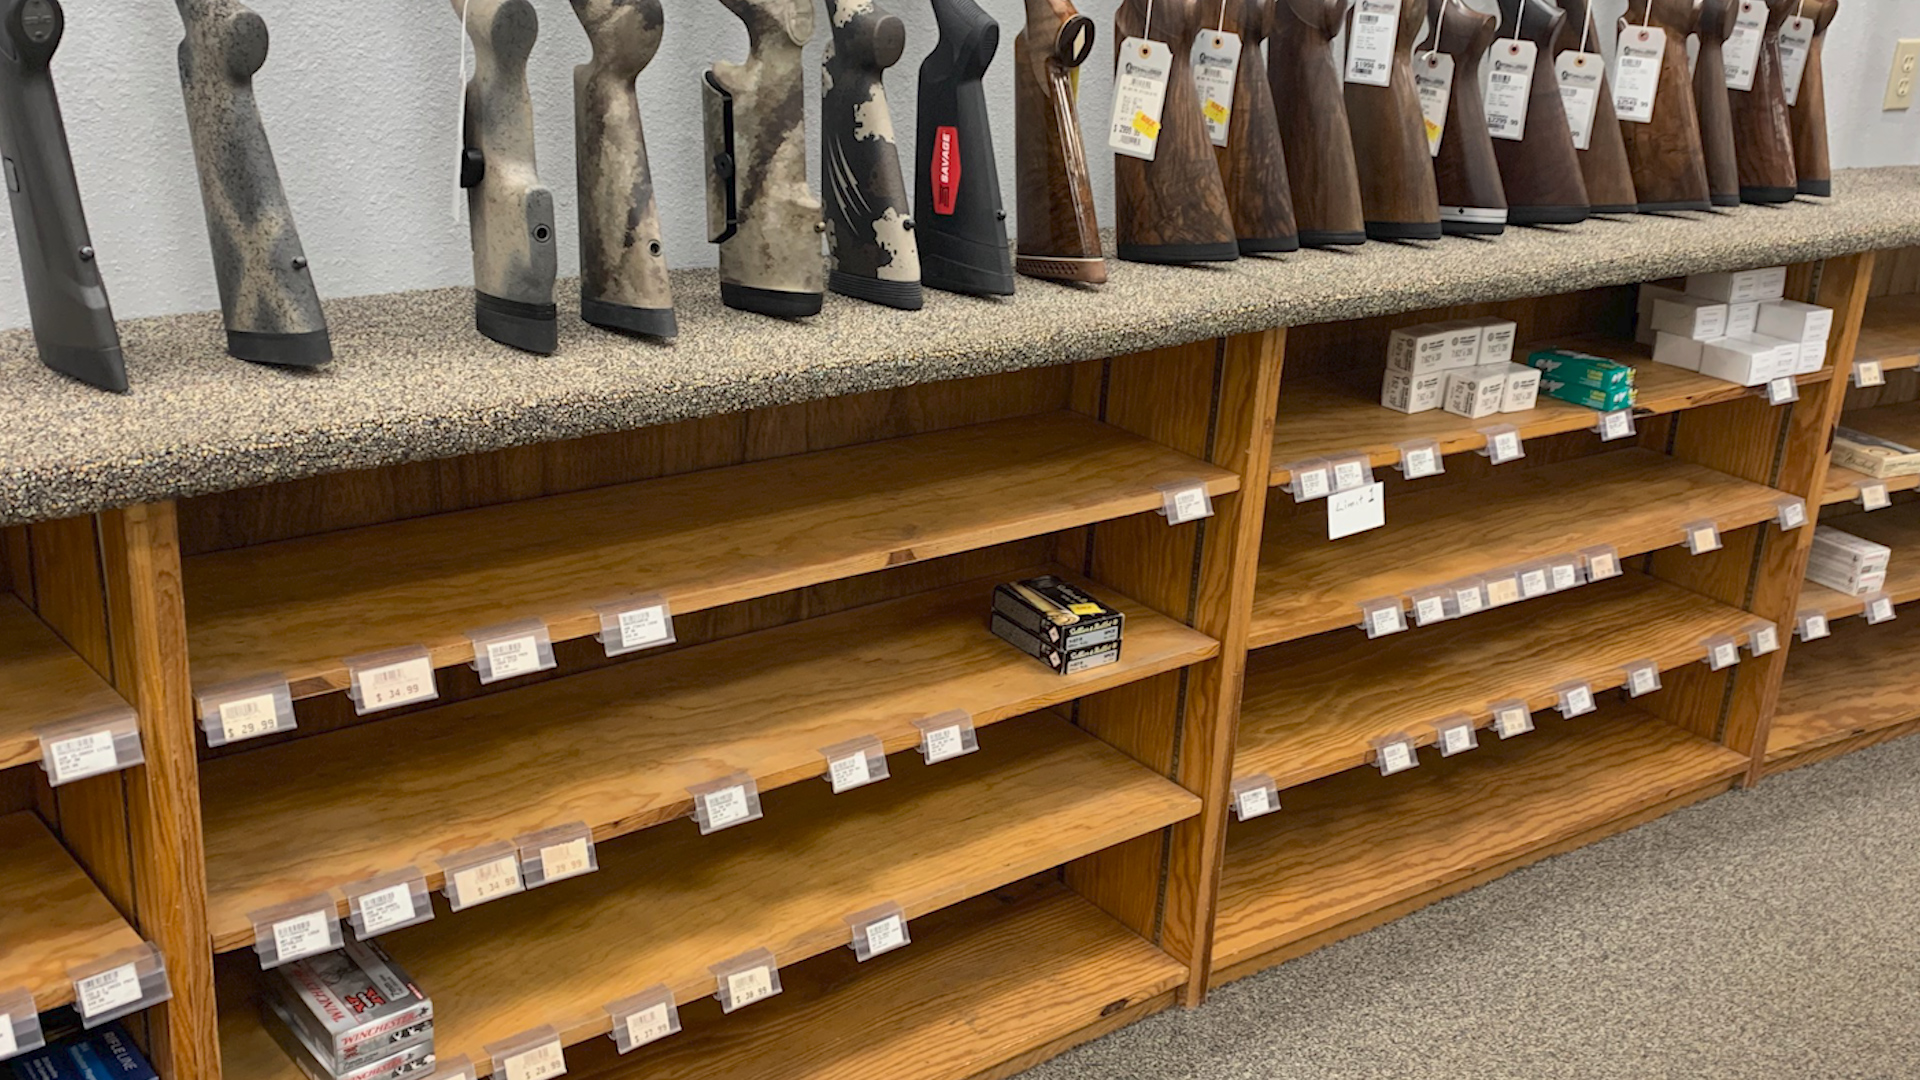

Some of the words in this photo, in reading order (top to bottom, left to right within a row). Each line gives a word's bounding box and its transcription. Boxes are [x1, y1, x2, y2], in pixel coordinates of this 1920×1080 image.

[940, 132, 951, 183] SAVAGE
[241, 718, 275, 734] 29.99
[341, 1011, 416, 1045] WINCHESTER
[103, 1030, 124, 1056] RIFLE
[117, 1050, 138, 1072] LINE
